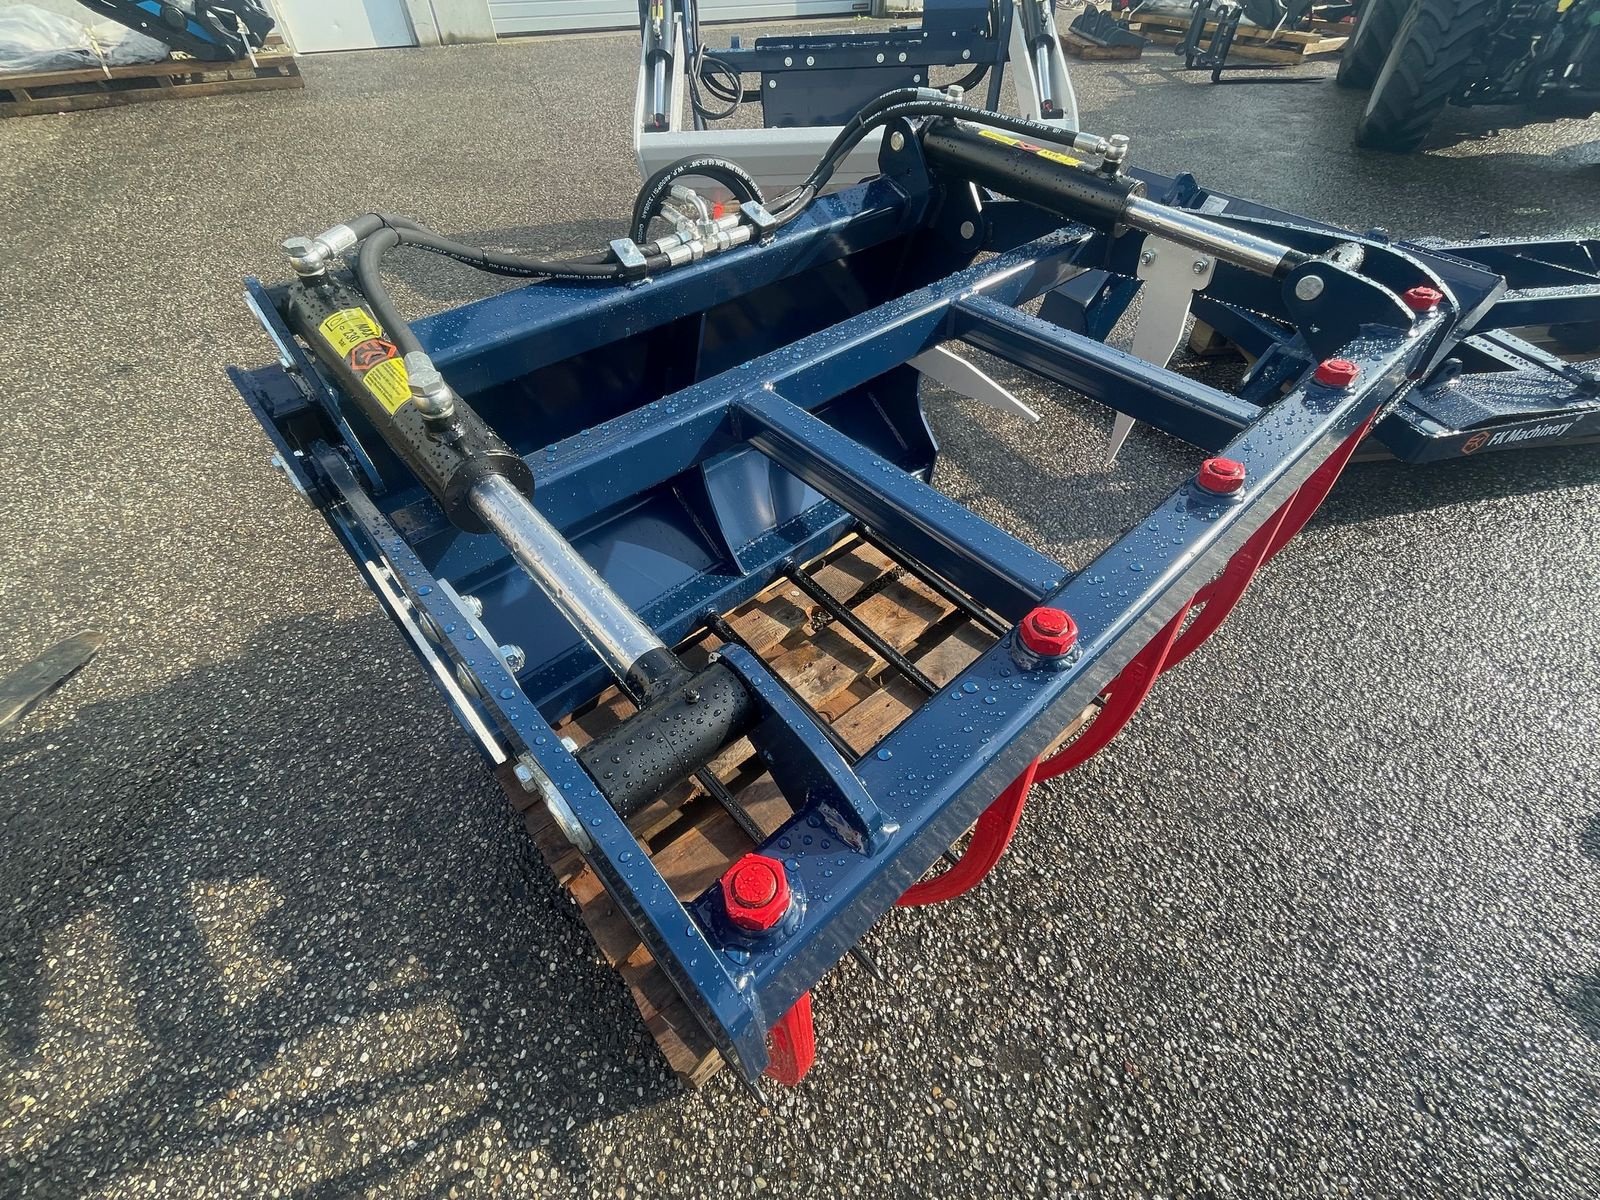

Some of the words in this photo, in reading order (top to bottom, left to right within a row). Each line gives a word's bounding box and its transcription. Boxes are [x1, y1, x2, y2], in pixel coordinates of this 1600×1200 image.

[1011, 116, 1026, 124] R2AT
[1036, 122, 1048, 131] SAE
[343, 328, 361, 344] 230
[1487, 432, 1510, 446] FK
[1504, 422, 1574, 443] Machinery
